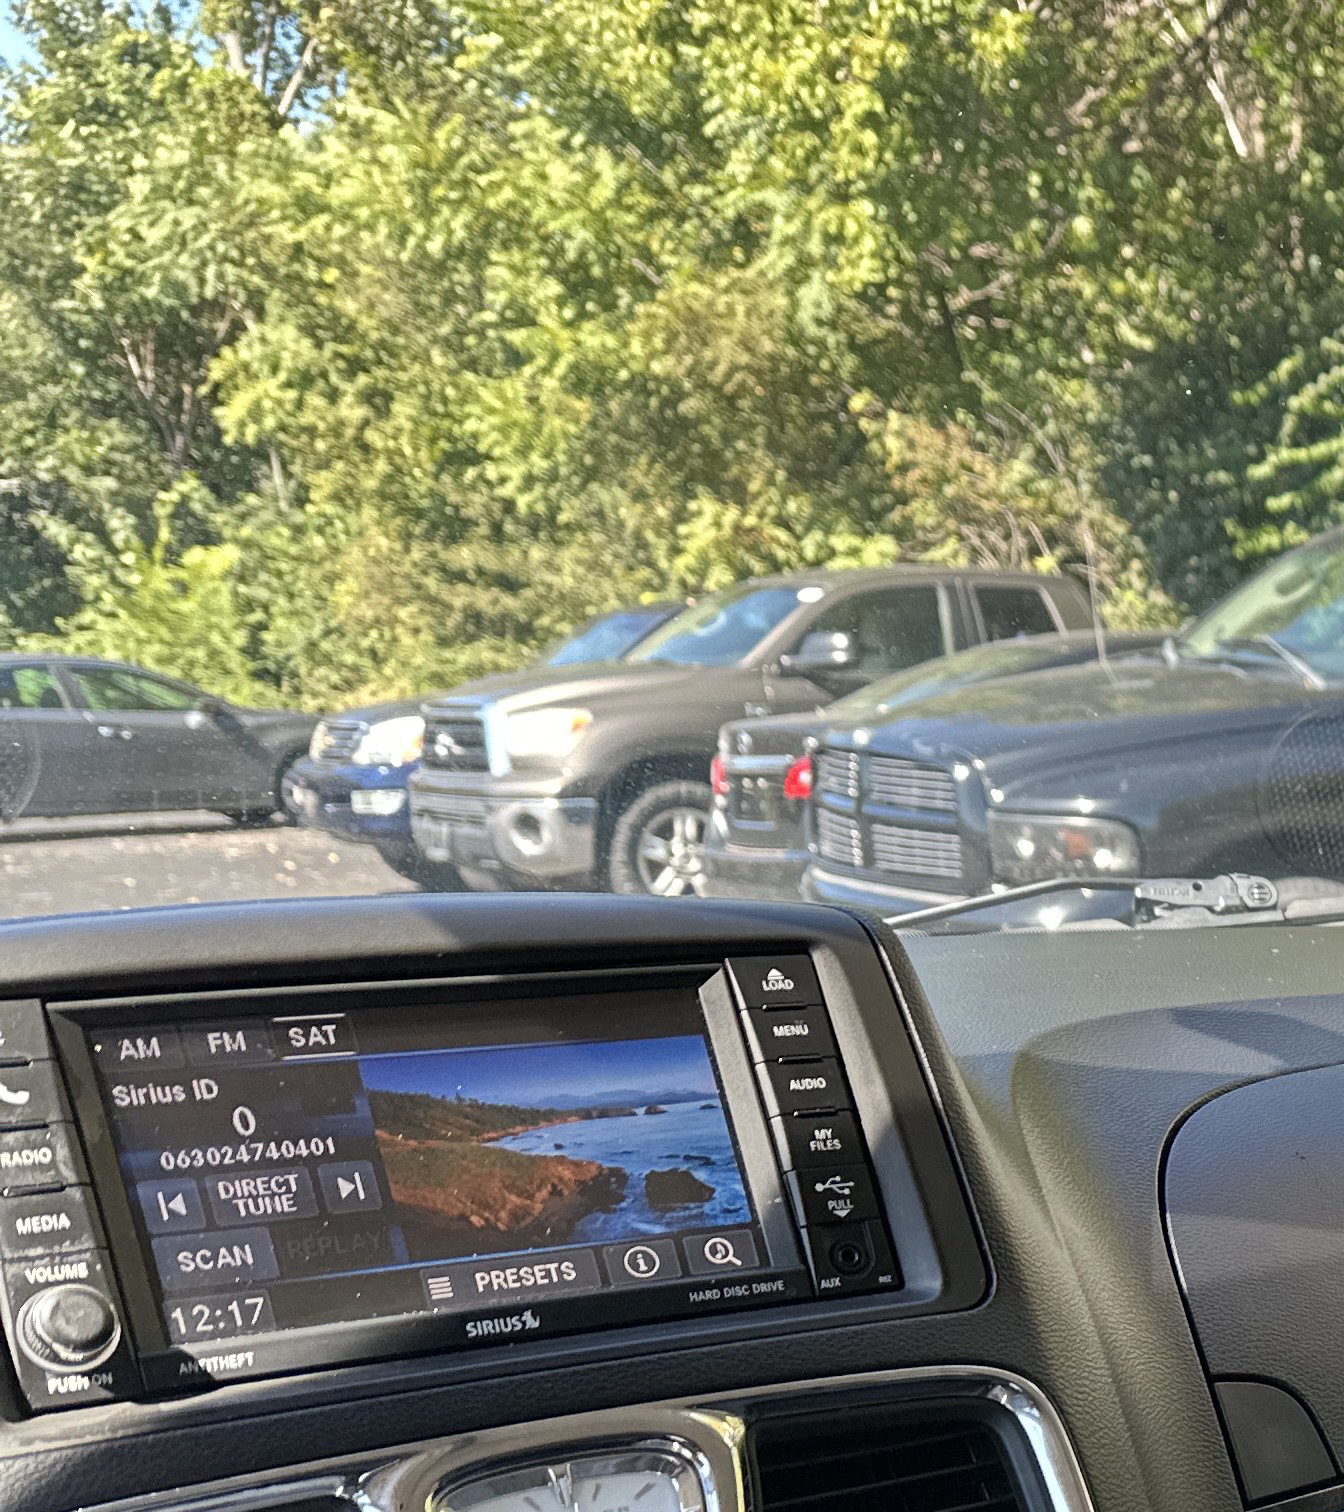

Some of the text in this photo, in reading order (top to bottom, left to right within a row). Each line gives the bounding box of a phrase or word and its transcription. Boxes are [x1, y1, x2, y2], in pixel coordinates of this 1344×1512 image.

[762, 979, 794, 991] LOAD
[288, 1025, 337, 1047] SAT
[773, 1023, 809, 1037] MENU
[119, 1037, 161, 1060] AM
[207, 1032, 247, 1054] FM
[112, 1078, 218, 1107] Sirius ID
[789, 1077, 826, 1090] AUDIO
[232, 1105, 256, 1136] 0
[809, 1139, 842, 1151] FILES
[814, 1129, 833, 1140] MY
[1, 1147, 53, 1168] RADIO
[160, 1137, 336, 1170] 063024740401
[217, 1173, 299, 1200] DIRECT
[232, 1194, 298, 1218] TUNE
[827, 1199, 854, 1210] PULL
[15, 1212, 71, 1236] MEDIA
[286, 1233, 382, 1259] REPLAY
[177, 1244, 254, 1272] SCAN
[24, 1262, 89, 1285] VOLUME
[474, 1262, 577, 1293] PRESETS
[820, 1276, 841, 1289] AUX
[689, 1280, 785, 1302] HARD DISC DRIVE
[171, 1297, 266, 1337] 12:17
[465, 1315, 524, 1338] SIRIUS
[179, 1351, 254, 1375] ANTITHEFT
[47, 1375, 90, 1395] PUSH
